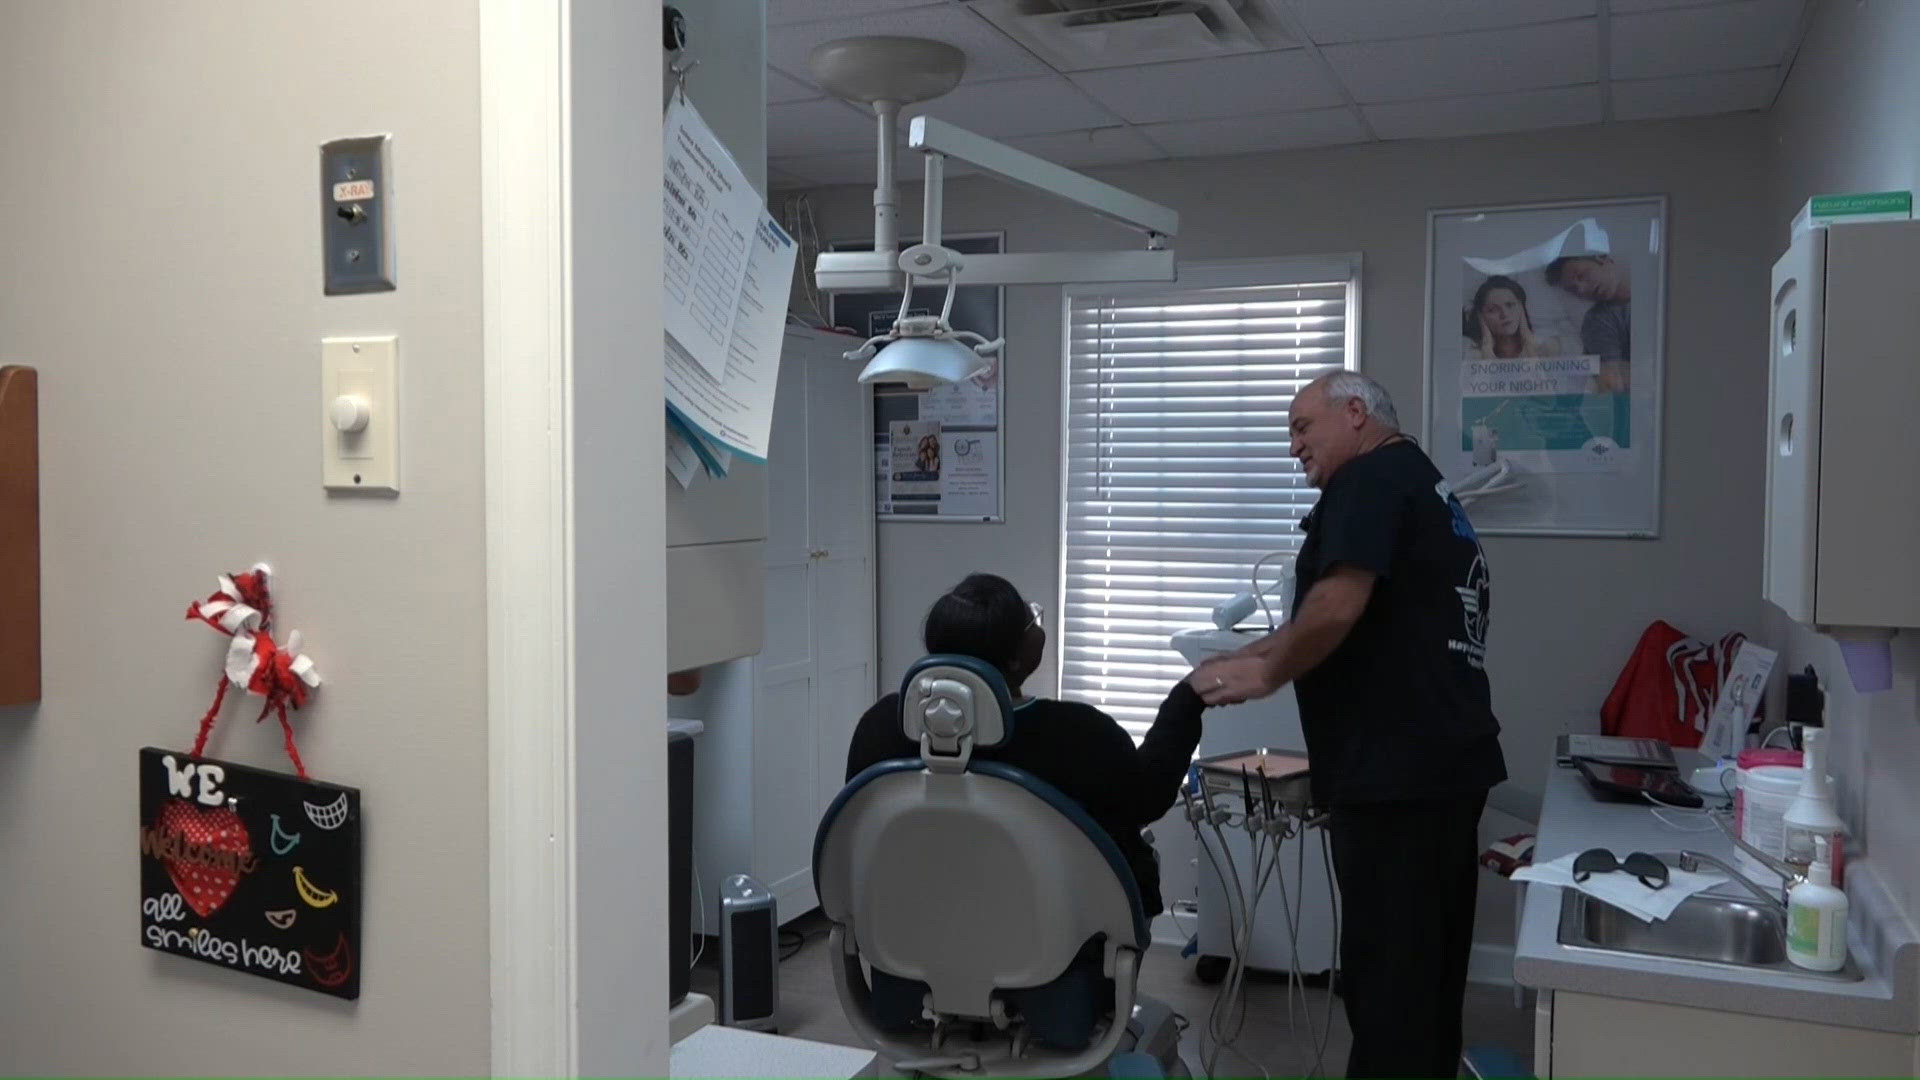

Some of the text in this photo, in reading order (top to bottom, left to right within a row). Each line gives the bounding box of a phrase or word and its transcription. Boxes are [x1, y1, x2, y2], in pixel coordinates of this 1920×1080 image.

[339, 183, 370, 198] X-RAY
[1813, 199, 1850, 210] natural
[1852, 197, 1906, 209] extensions
[1470, 359, 1591, 375] SNORING RUINING
[1470, 378, 1559, 393] YOUR NIGHT?
[162, 754, 225, 806] WE
[143, 892, 187, 922] all
[146, 924, 302, 974] smiles here
